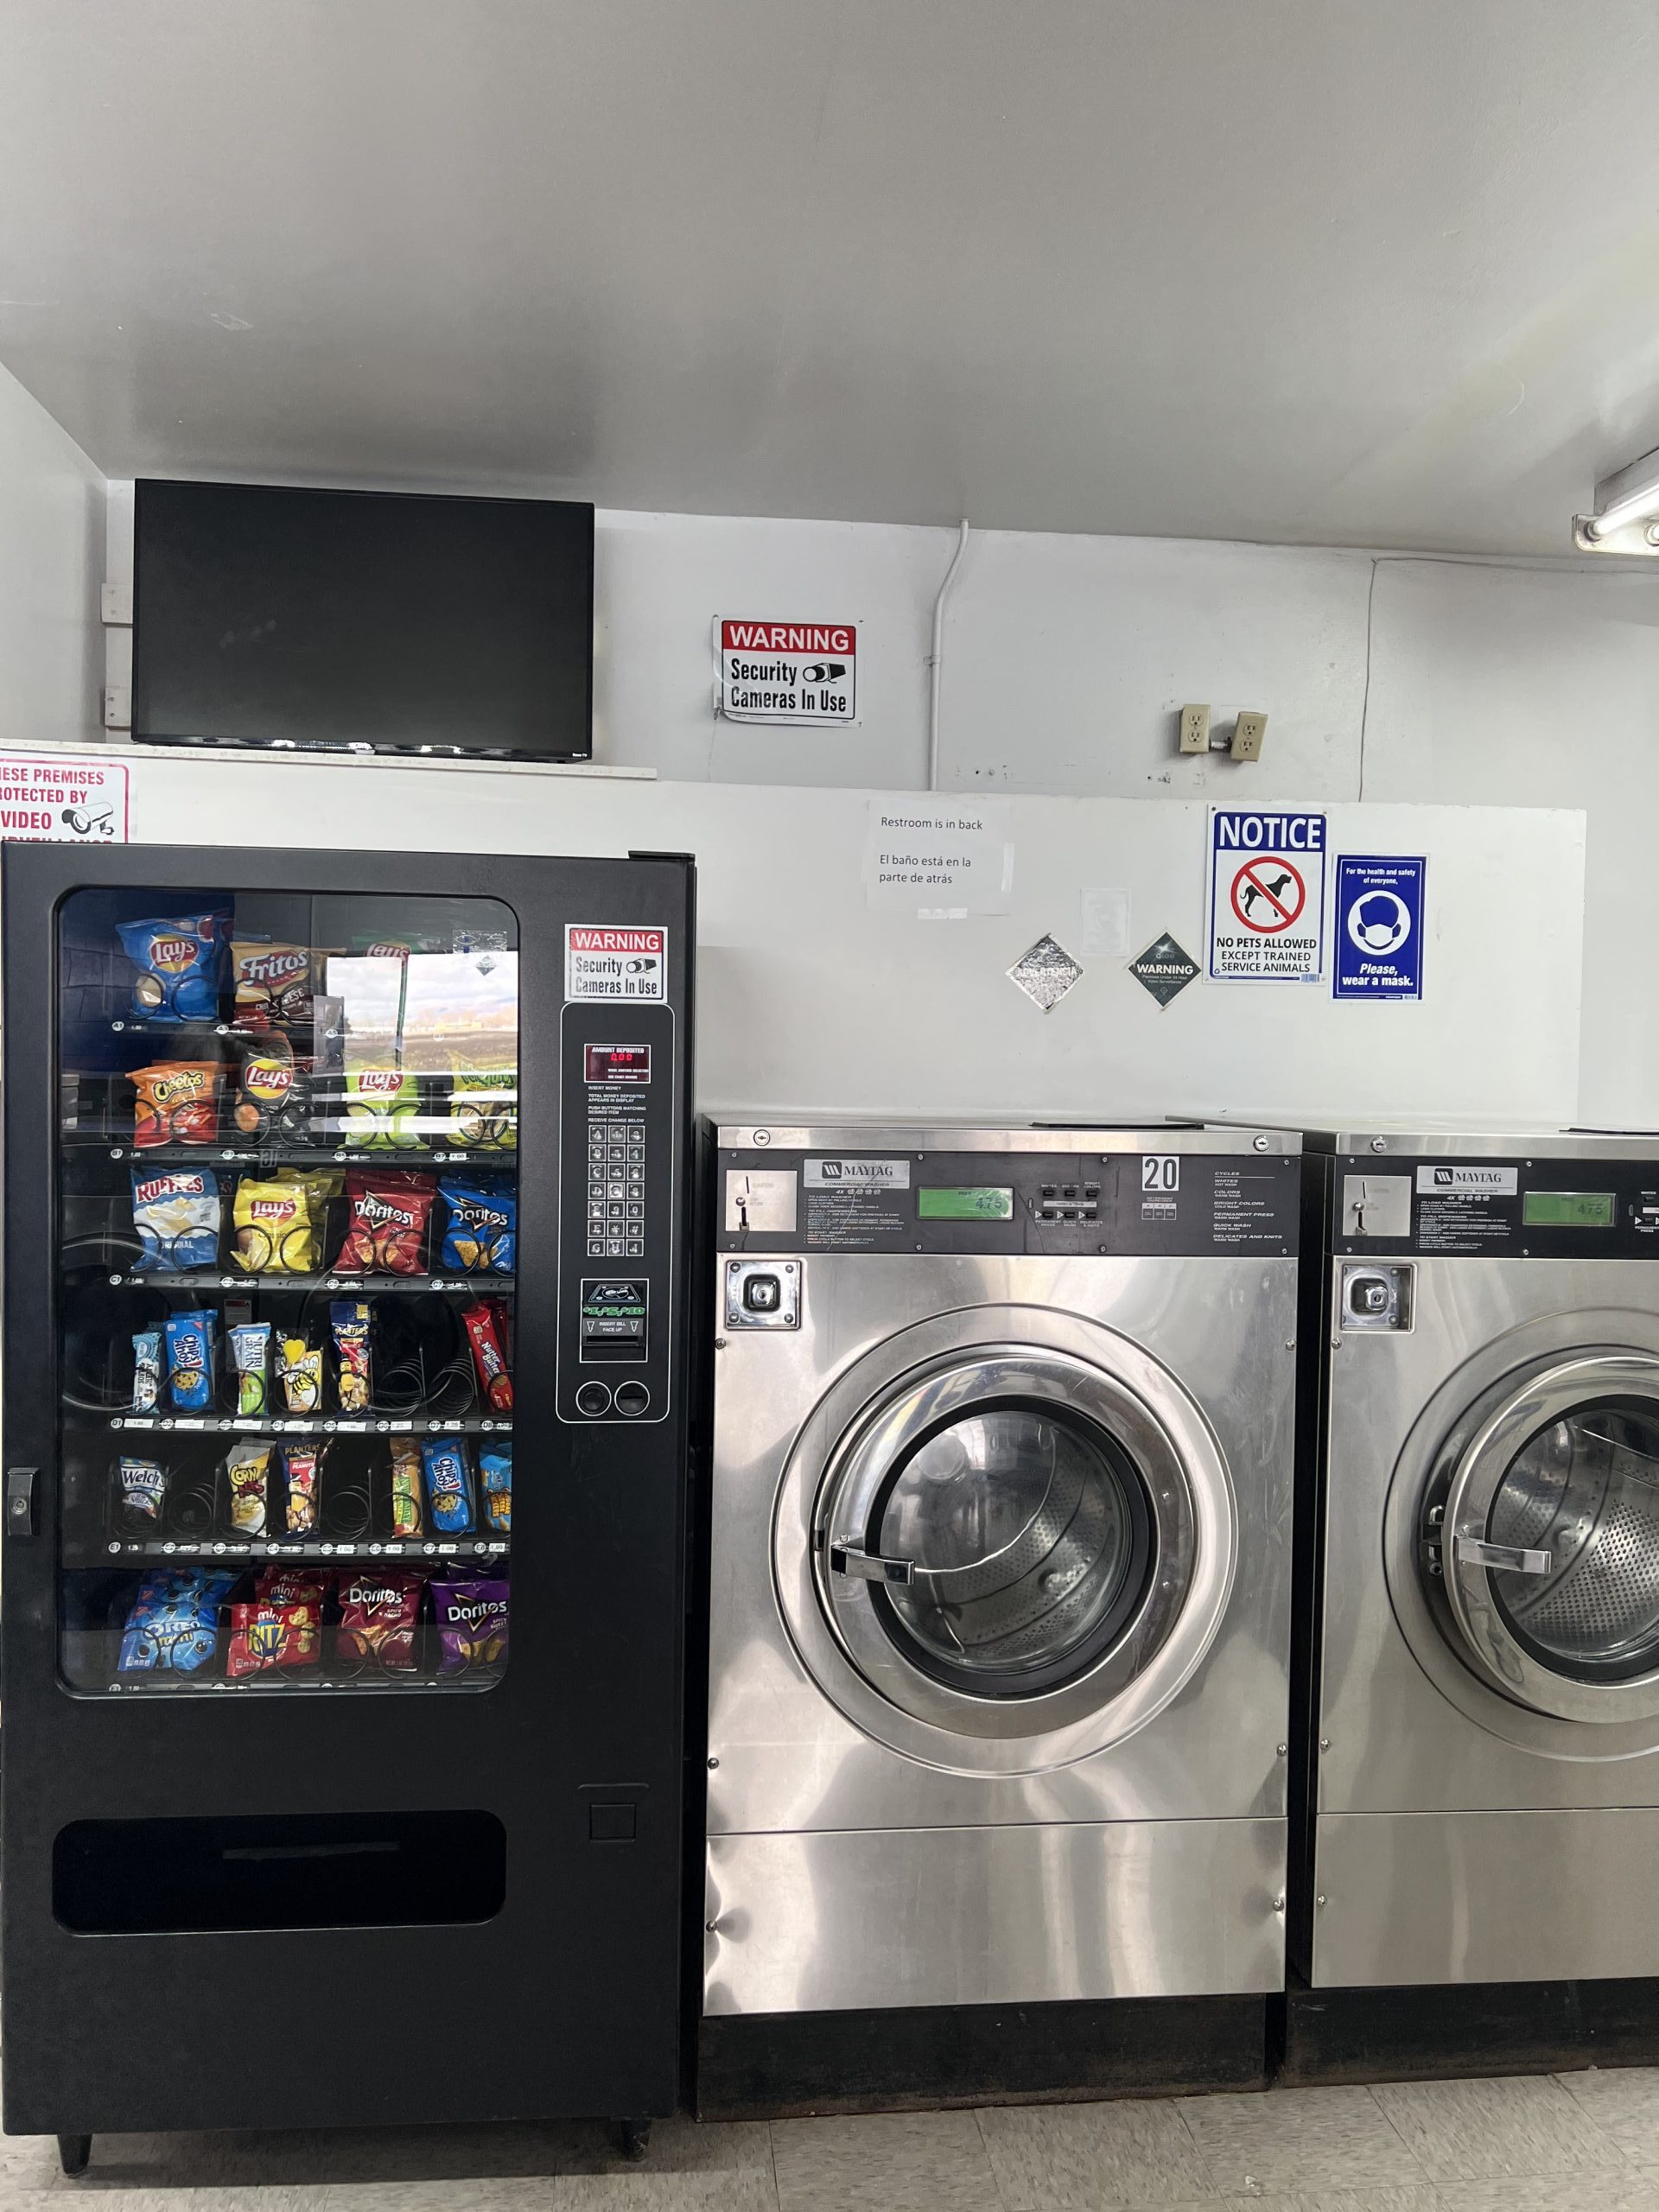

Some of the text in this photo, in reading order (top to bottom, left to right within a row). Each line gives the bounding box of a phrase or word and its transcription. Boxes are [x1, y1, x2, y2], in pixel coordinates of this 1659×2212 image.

[730, 626, 849, 652] WARNING
[732, 658, 797, 686] Security
[732, 686, 846, 712] Cameras In Use
[0, 767, 105, 785] ESE PREMISES
[70, 791, 87, 804] BY
[1, 810, 52, 830] VIDEO
[881, 817, 982, 830] Restroom is in back
[1219, 817, 1321, 849] NOTICE
[880, 855, 971, 867] El baño está en la
[879, 873, 952, 884] parte de atrás
[1398, 868, 1416, 877] safety
[575, 932, 659, 950] WARNING
[1217, 937, 1317, 949] NO PETS ALLOWED
[1222, 950, 1311, 961] EXCEPT TRAINED
[239, 951, 308, 986] Fritos
[575, 957, 623, 976] Security
[1136, 963, 1193, 975] WARNING
[1222, 962, 1310, 973] SERVICE ANIMALS
[1359, 963, 1398, 976] Please,
[575, 976, 657, 994] Cameras In Use
[1343, 976, 1370, 985] wear
[1381, 975, 1414, 986] mask.
[155, 1071, 204, 1102] Cheetos
[247, 1067, 291, 1089] Lay's
[844, 1166, 893, 1176] MAYTAG
[1144, 1158, 1177, 1190] 20
[1455, 1173, 1502, 1183] MAYTAG
[253, 1200, 295, 1219] Lay's
[354, 1200, 410, 1224] Doritos
[452, 1209, 508, 1226] Doritos
[182, 1334, 201, 1362] Chips
[480, 1341, 500, 1363] Nutter
[481, 1352, 500, 1373] Butter
[230, 1465, 257, 1486] CORN
[441, 1458, 458, 1484] Chips
[349, 1587, 403, 1605] Doritos
[448, 1600, 508, 1622] Doritos
[248, 1623, 286, 1652] RITZ
